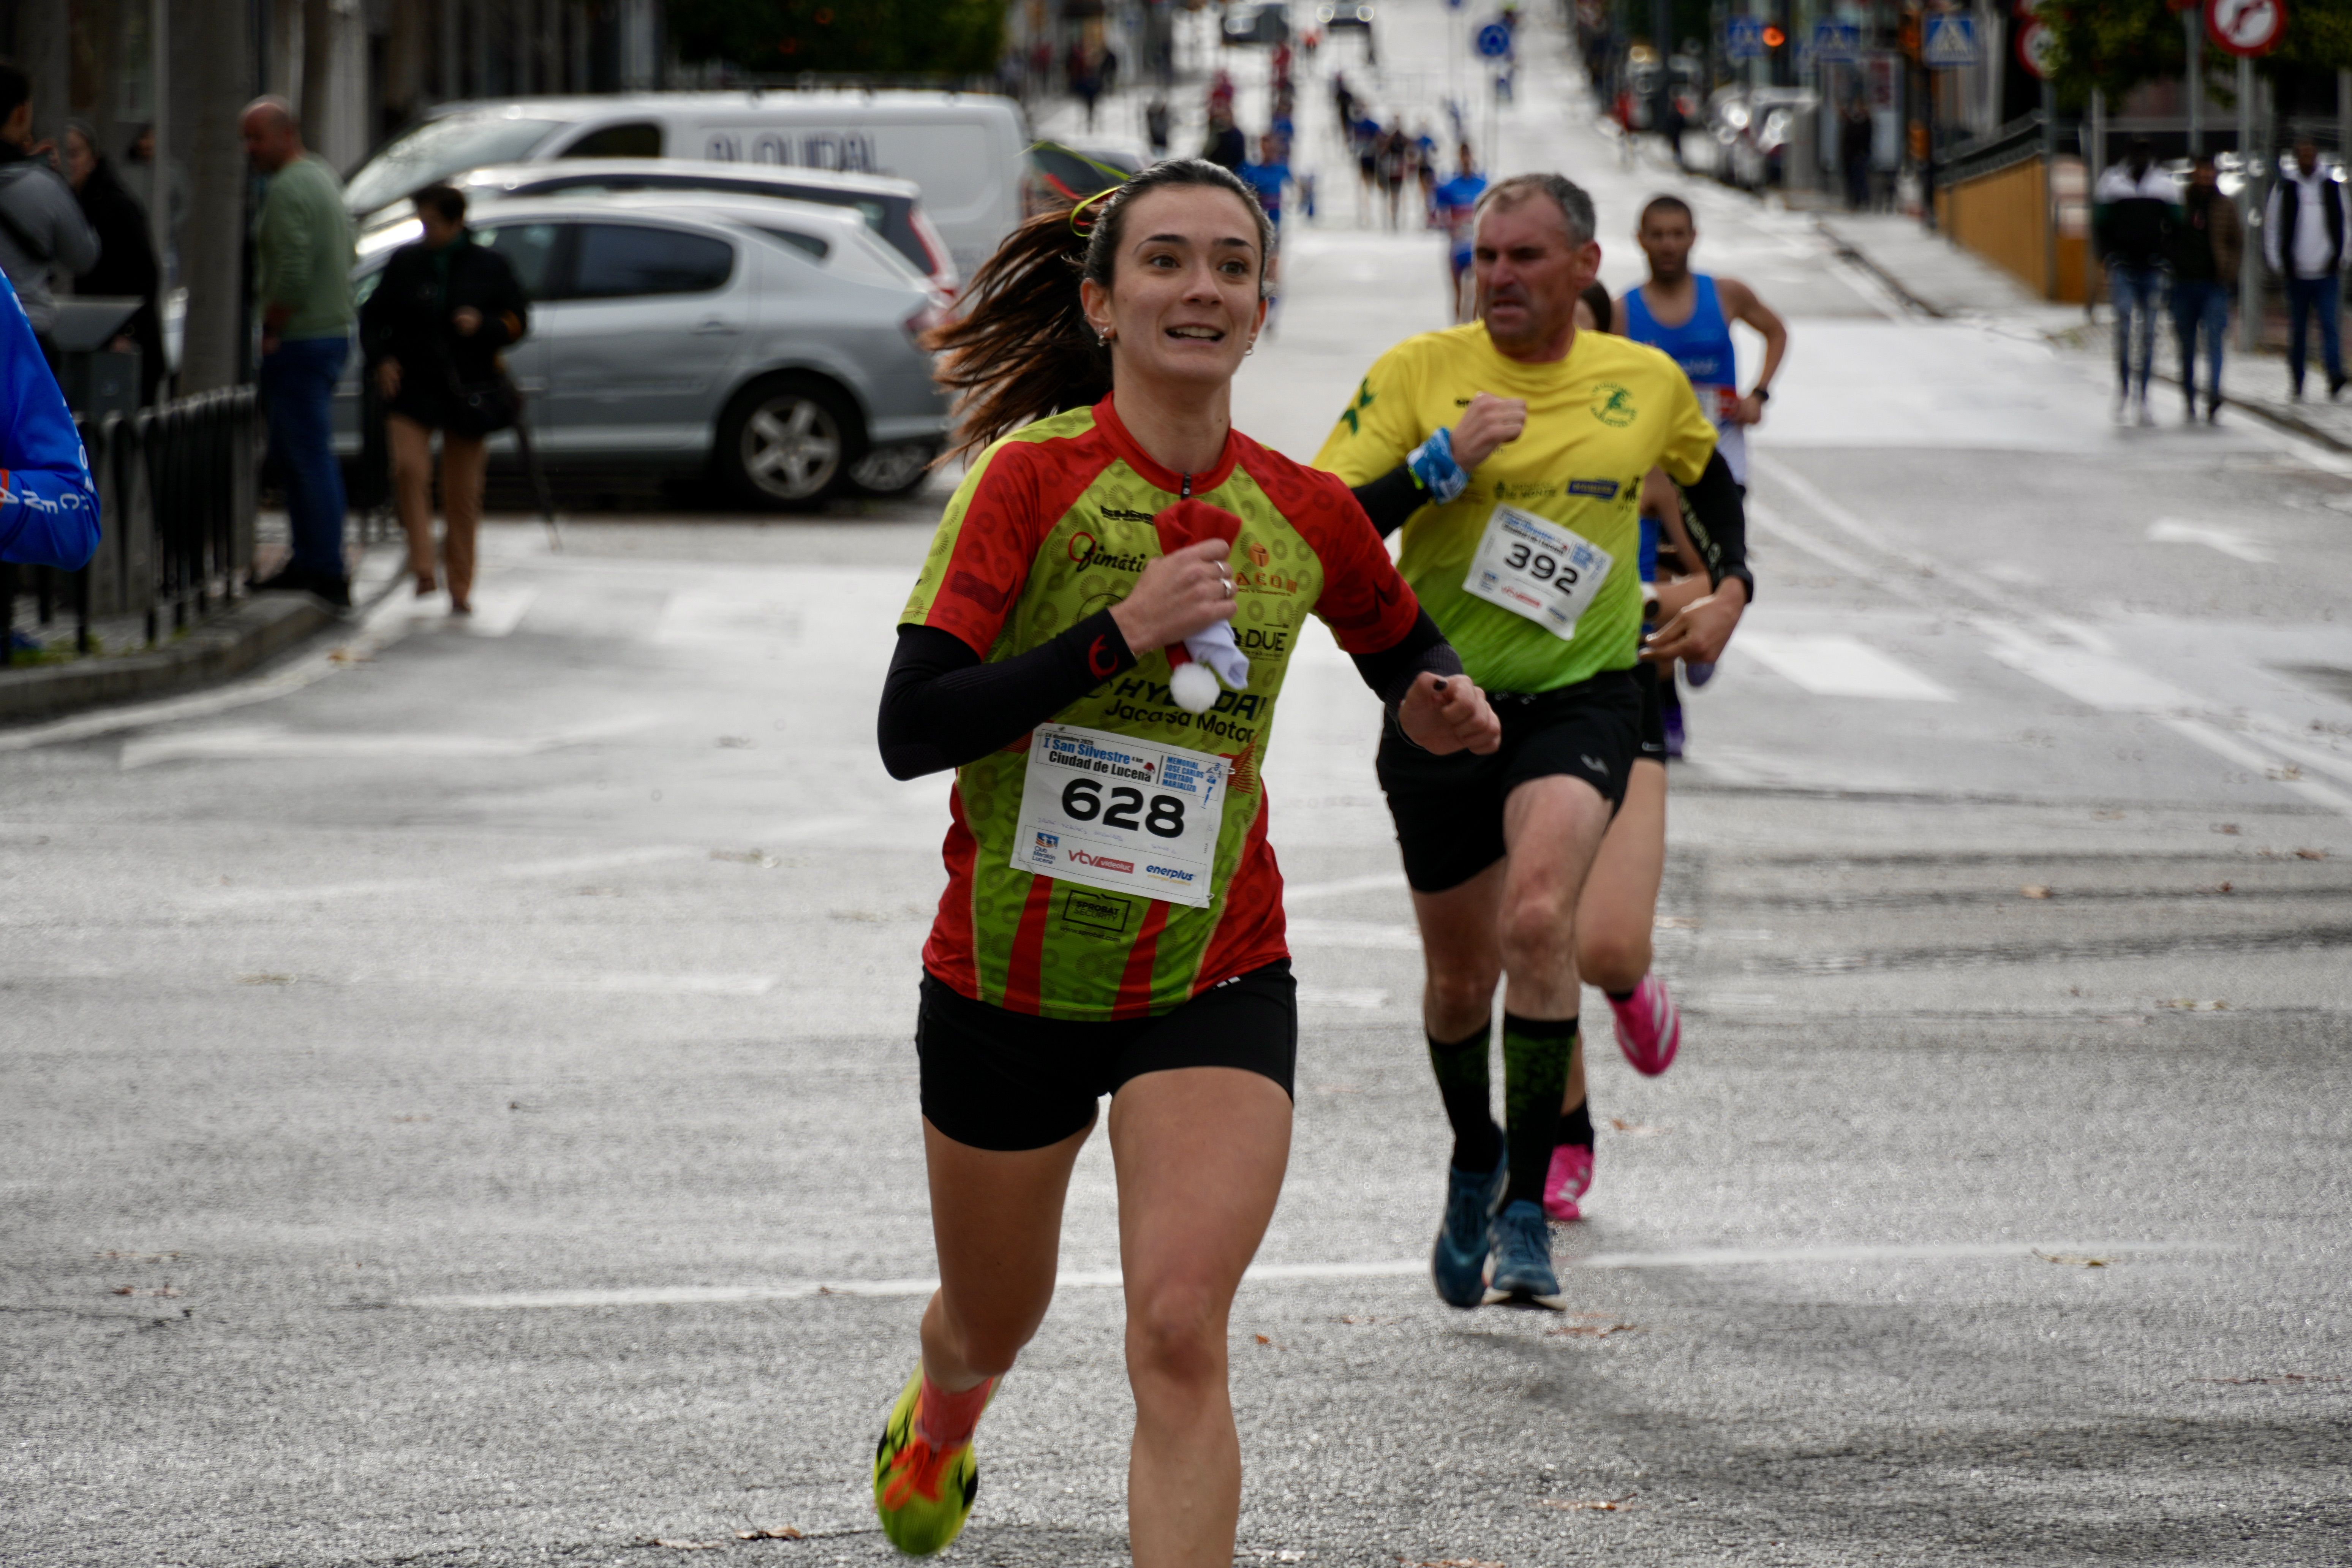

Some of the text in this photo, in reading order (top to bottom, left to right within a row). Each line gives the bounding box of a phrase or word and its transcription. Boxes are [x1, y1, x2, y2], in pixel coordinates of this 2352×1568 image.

[1068, 531, 1146, 572] Ofimáti
[1503, 542, 1579, 597] 392
[1114, 678, 1268, 721] HYDAI
[1105, 699, 1254, 743] Jacasa Motor
[1052, 740, 1075, 753] San
[1077, 744, 1131, 765] Silvestre
[1049, 751, 1151, 782] Ciudad de Lucena
[1167, 756, 1198, 770] MEMORIAL
[1182, 767, 1204, 779] CARLOS
[1062, 778, 1185, 839] 628
[1032, 855, 1053, 865] Lucena
[1033, 850, 1056, 860] Maratón
[1101, 859, 1132, 871] videoluc
[1146, 865, 1194, 881] enerplus
[1074, 907, 1118, 921] SECURITY
[1076, 901, 1120, 915] SPROBAT
